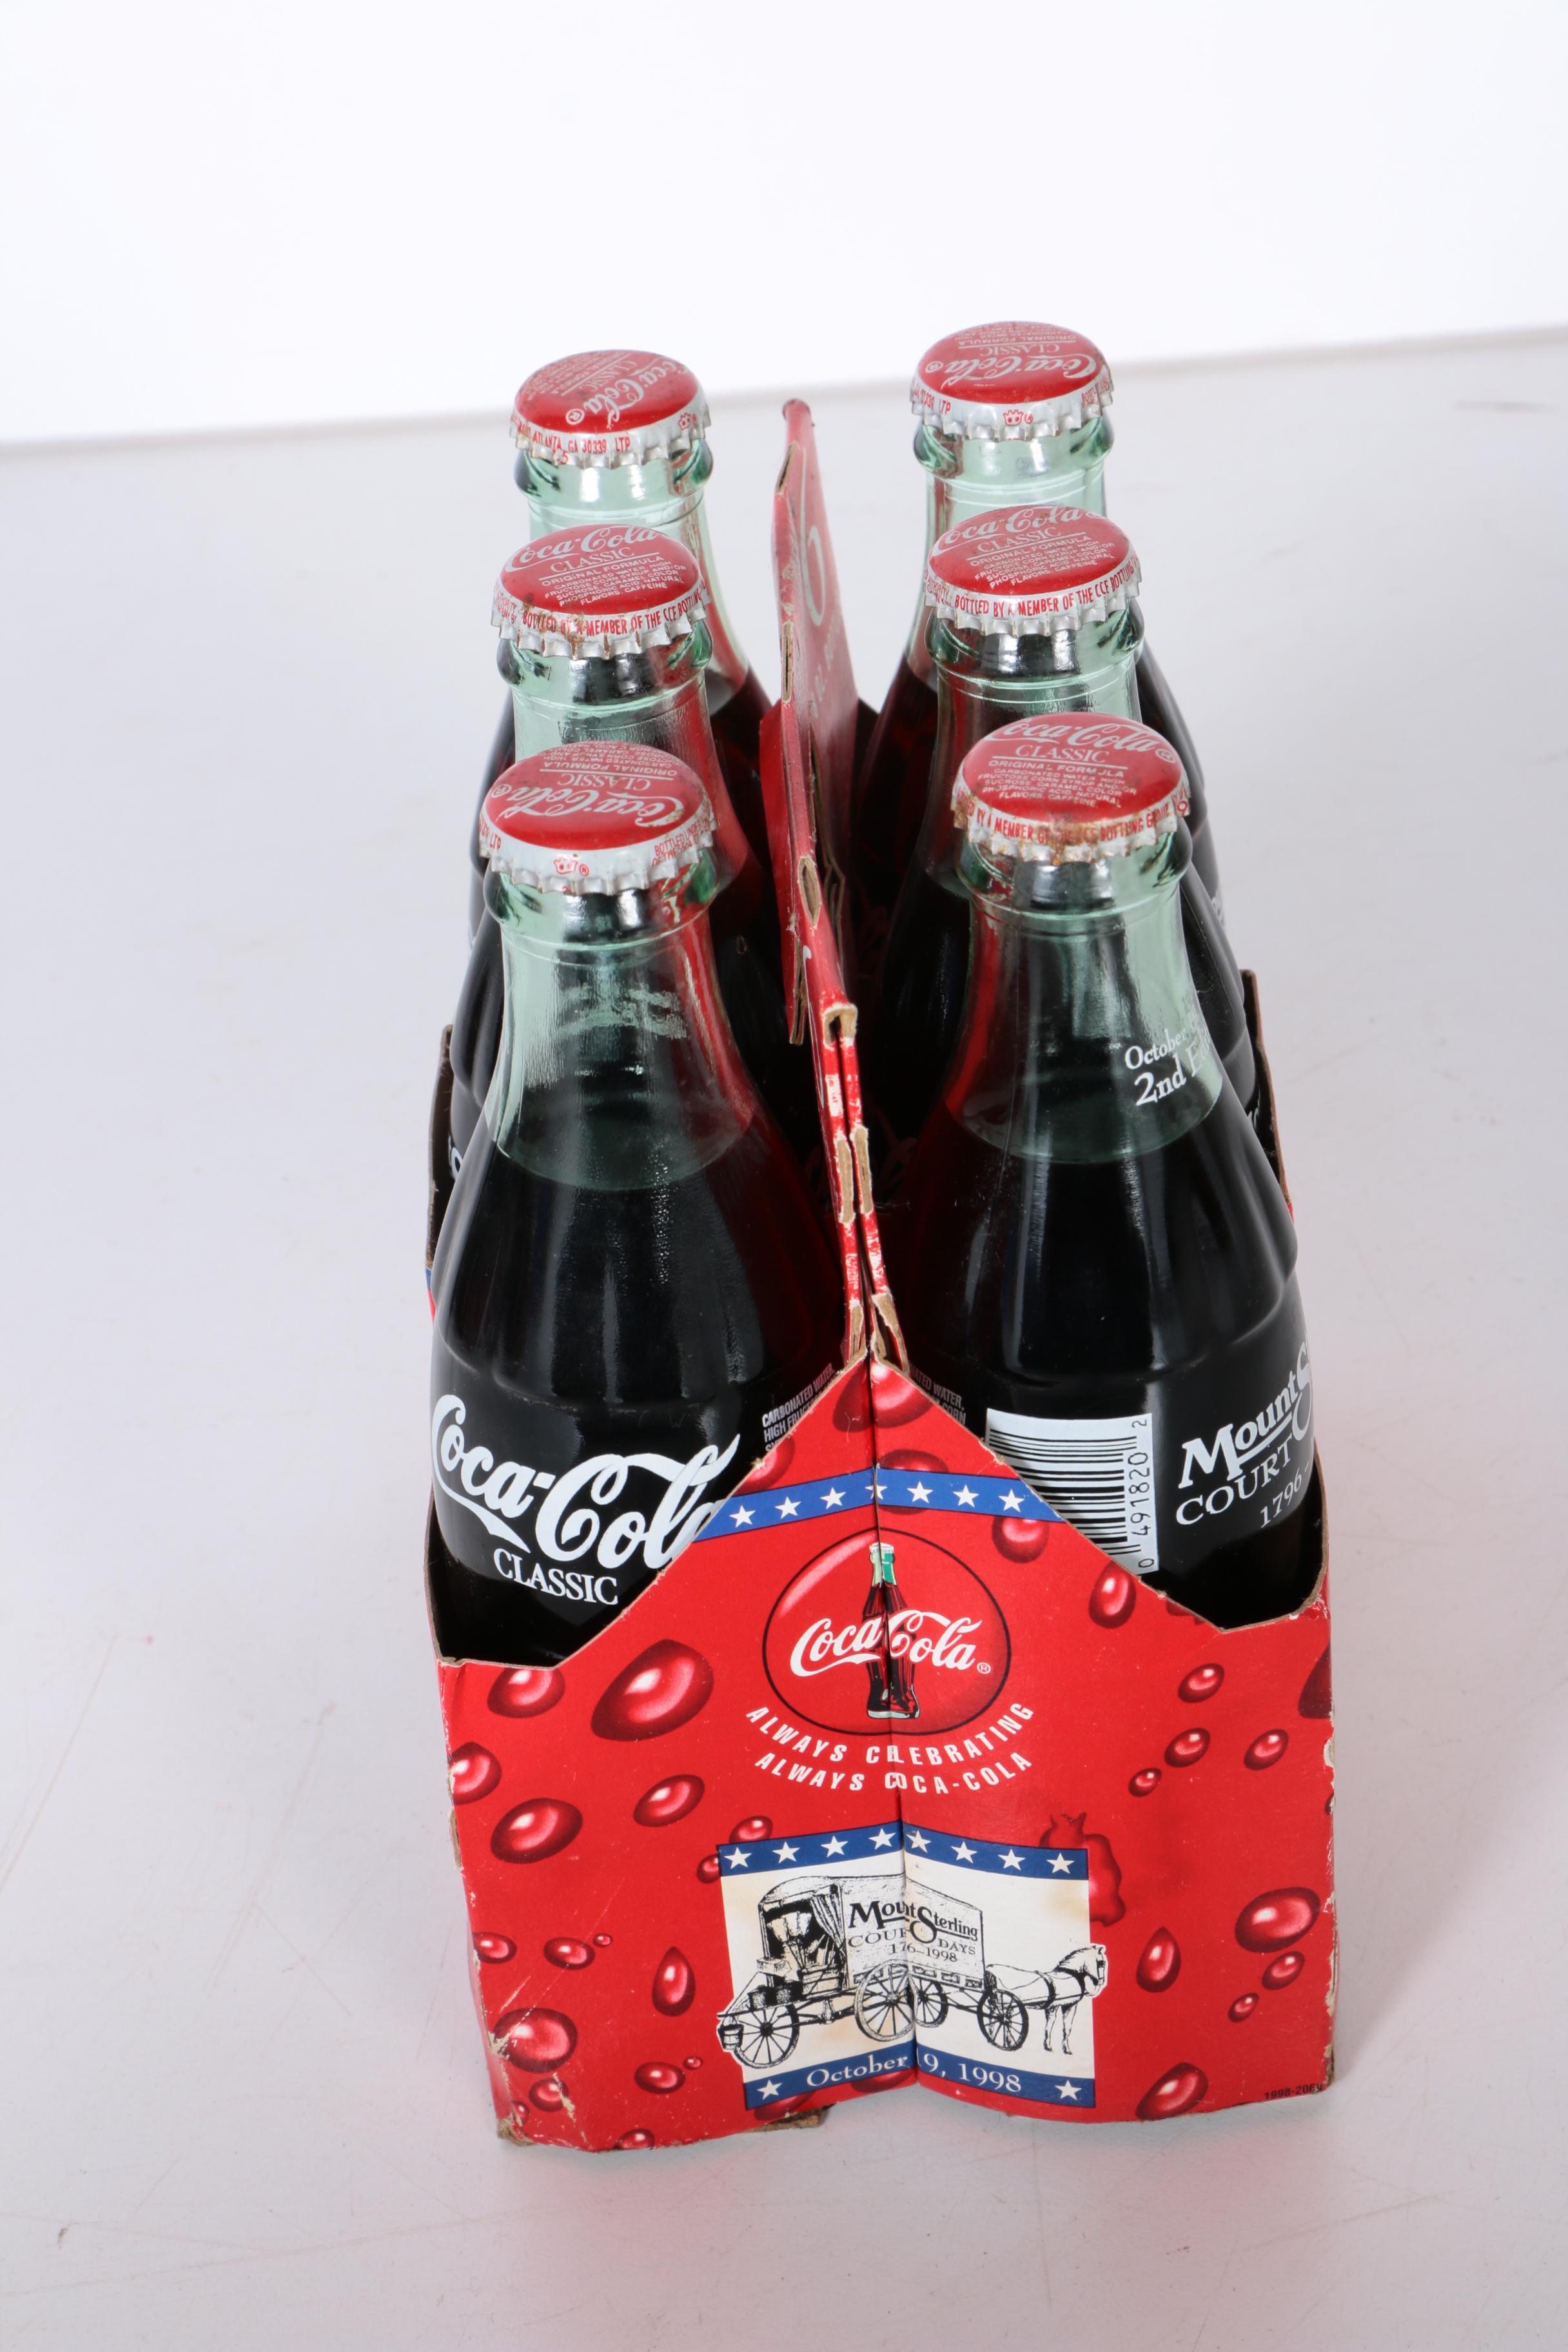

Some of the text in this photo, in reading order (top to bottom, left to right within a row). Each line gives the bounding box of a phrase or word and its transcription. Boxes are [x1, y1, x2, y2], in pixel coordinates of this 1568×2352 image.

[979, 343, 1059, 357] CLASSIC
[940, 353, 1097, 390] Coca-Cola
[939, 398, 952, 416] LTP
[533, 429, 631, 454] ATLANTA GA 30339 LTP
[505, 525, 658, 573] Coca-Cola
[970, 534, 1092, 567] ORIGINAL FORMULA
[977, 527, 1062, 553] CLASSIC
[542, 555, 665, 587] ORIGINAL FORMULA
[550, 547, 636, 573] CLASSIC
[544, 563, 687, 600] FRUCTOSE CORN SYRUP AND/OR
[554, 573, 614, 589] CARBONATED
[603, 574, 648, 589] CARAMEL
[647, 569, 679, 579] COLOR
[624, 582, 668, 594] CAFFEINE
[990, 565, 1048, 589] PHOSPHORIC
[558, 585, 619, 607] PHOSPHORIC
[643, 575, 685, 584] NATURAL
[954, 594, 990, 615] BOTTLED
[993, 600, 1005, 618] BY
[1007, 602, 1014, 615] A
[1017, 596, 1059, 616] MEMBER
[1063, 593, 1075, 611] OF
[1075, 587, 1094, 605] THE
[522, 610, 556, 633] BOTTLED
[585, 614, 627, 637] MEMBER
[631, 613, 643, 630] OF
[645, 611, 662, 628] THE
[985, 719, 1157, 753] Coca-Cola
[1015, 744, 1110, 763] CLASSIC
[544, 761, 678, 776] FORMULA ORIGINAL
[977, 773, 1030, 781] FRUCTOSE
[994, 767, 1061, 778] CARBONATED
[557, 773, 651, 792] CLASSIC
[1037, 781, 1084, 792] CARAMEL
[1086, 786, 1122, 797] COLOR
[495, 785, 685, 827] Coca-Cola
[982, 785, 1047, 794] PHOSPHORIC
[1075, 790, 1122, 808] NATURAL
[1048, 793, 1097, 807] CAFFEINE
[994, 817, 1032, 841] MEMBER
[1124, 1028, 1189, 1070] October
[1134, 1052, 1187, 1106] 2nd
[762, 1384, 813, 1428] CARBONATED
[763, 1420, 787, 1443] HIGH
[1178, 1370, 1299, 1489] Mount
[1176, 1433, 1293, 1525] COURT
[493, 1547, 618, 1605] CLASSIC
[790, 1609, 983, 1677] CocaCola
[745, 1705, 848, 1763] ALWAYS
[754, 1751, 1033, 1794] ALWAYS COCA-COLA
[848, 1900, 979, 1944] Mount Sterling
[937, 1937, 976, 1955] DAYS
[806, 2054, 908, 2088] October
[958, 2063, 1022, 2093] 1998
